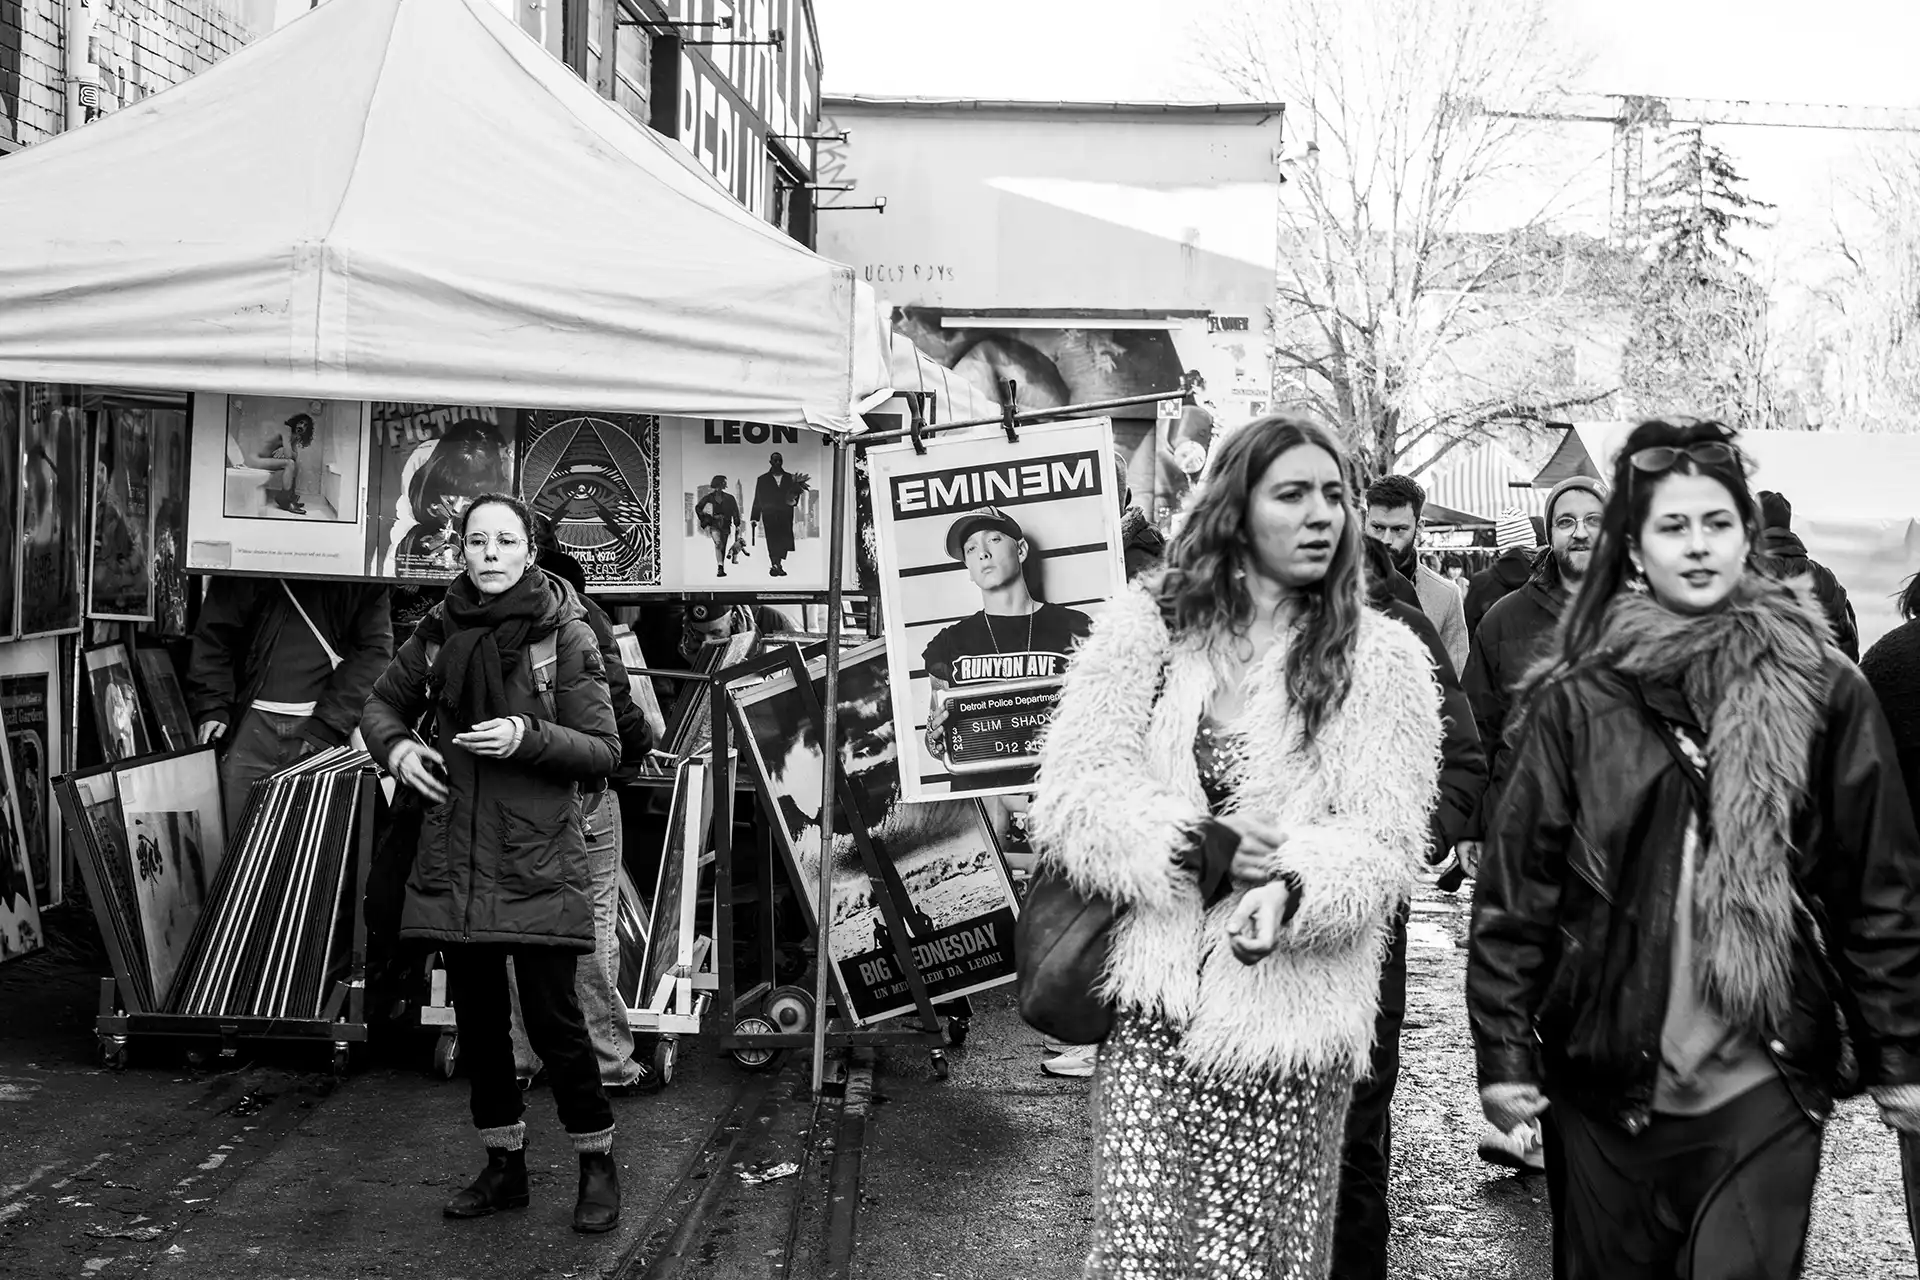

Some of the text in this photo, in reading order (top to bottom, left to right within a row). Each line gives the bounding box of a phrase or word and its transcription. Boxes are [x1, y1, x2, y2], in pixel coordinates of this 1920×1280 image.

[897, 458, 1094, 512] EMINEM
[597, 551, 617, 562] 1970
[961, 656, 1024, 680] RUNYON
[960, 701, 987, 712] Detroit
[988, 698, 1014, 708] Police
[972, 720, 1002, 732] SLIM
[953, 743, 964, 751] 04
[995, 741, 1019, 753] D12
[859, 922, 998, 986] BIG EDNESDAY
[873, 987, 889, 999] UN
[949, 965, 963, 977] DA
[967, 952, 1004, 971] LEONI
